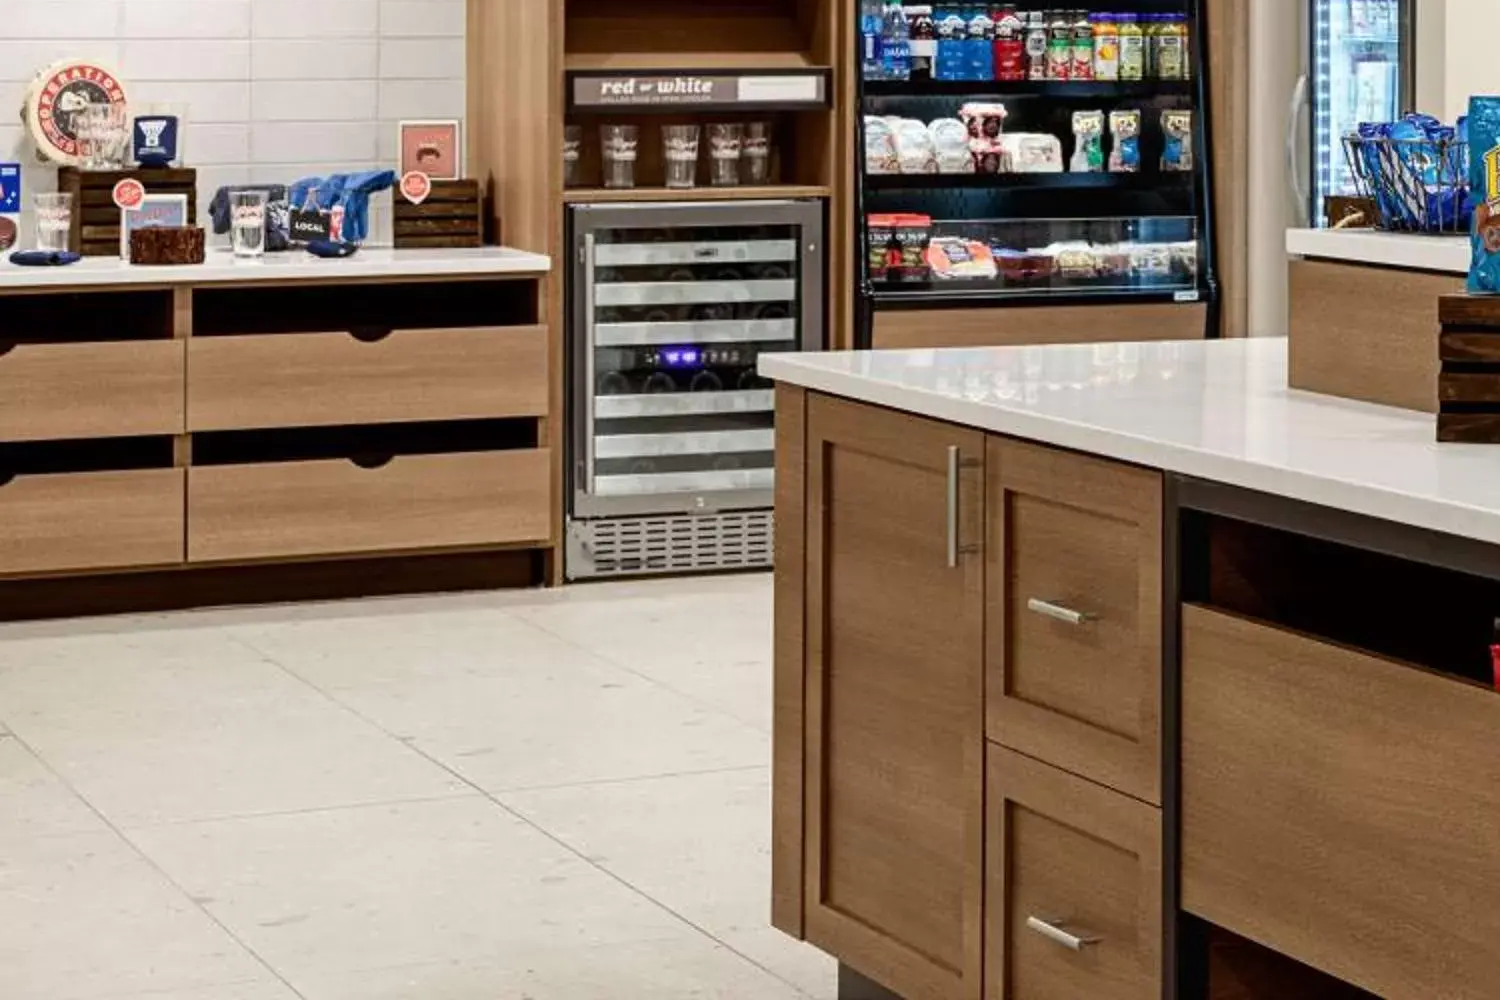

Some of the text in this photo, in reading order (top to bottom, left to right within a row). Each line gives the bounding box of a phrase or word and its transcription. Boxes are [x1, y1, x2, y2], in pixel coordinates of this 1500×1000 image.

[600, 77, 636, 95] red
[657, 76, 714, 94] white
[295, 222, 324, 233] LOCAL
